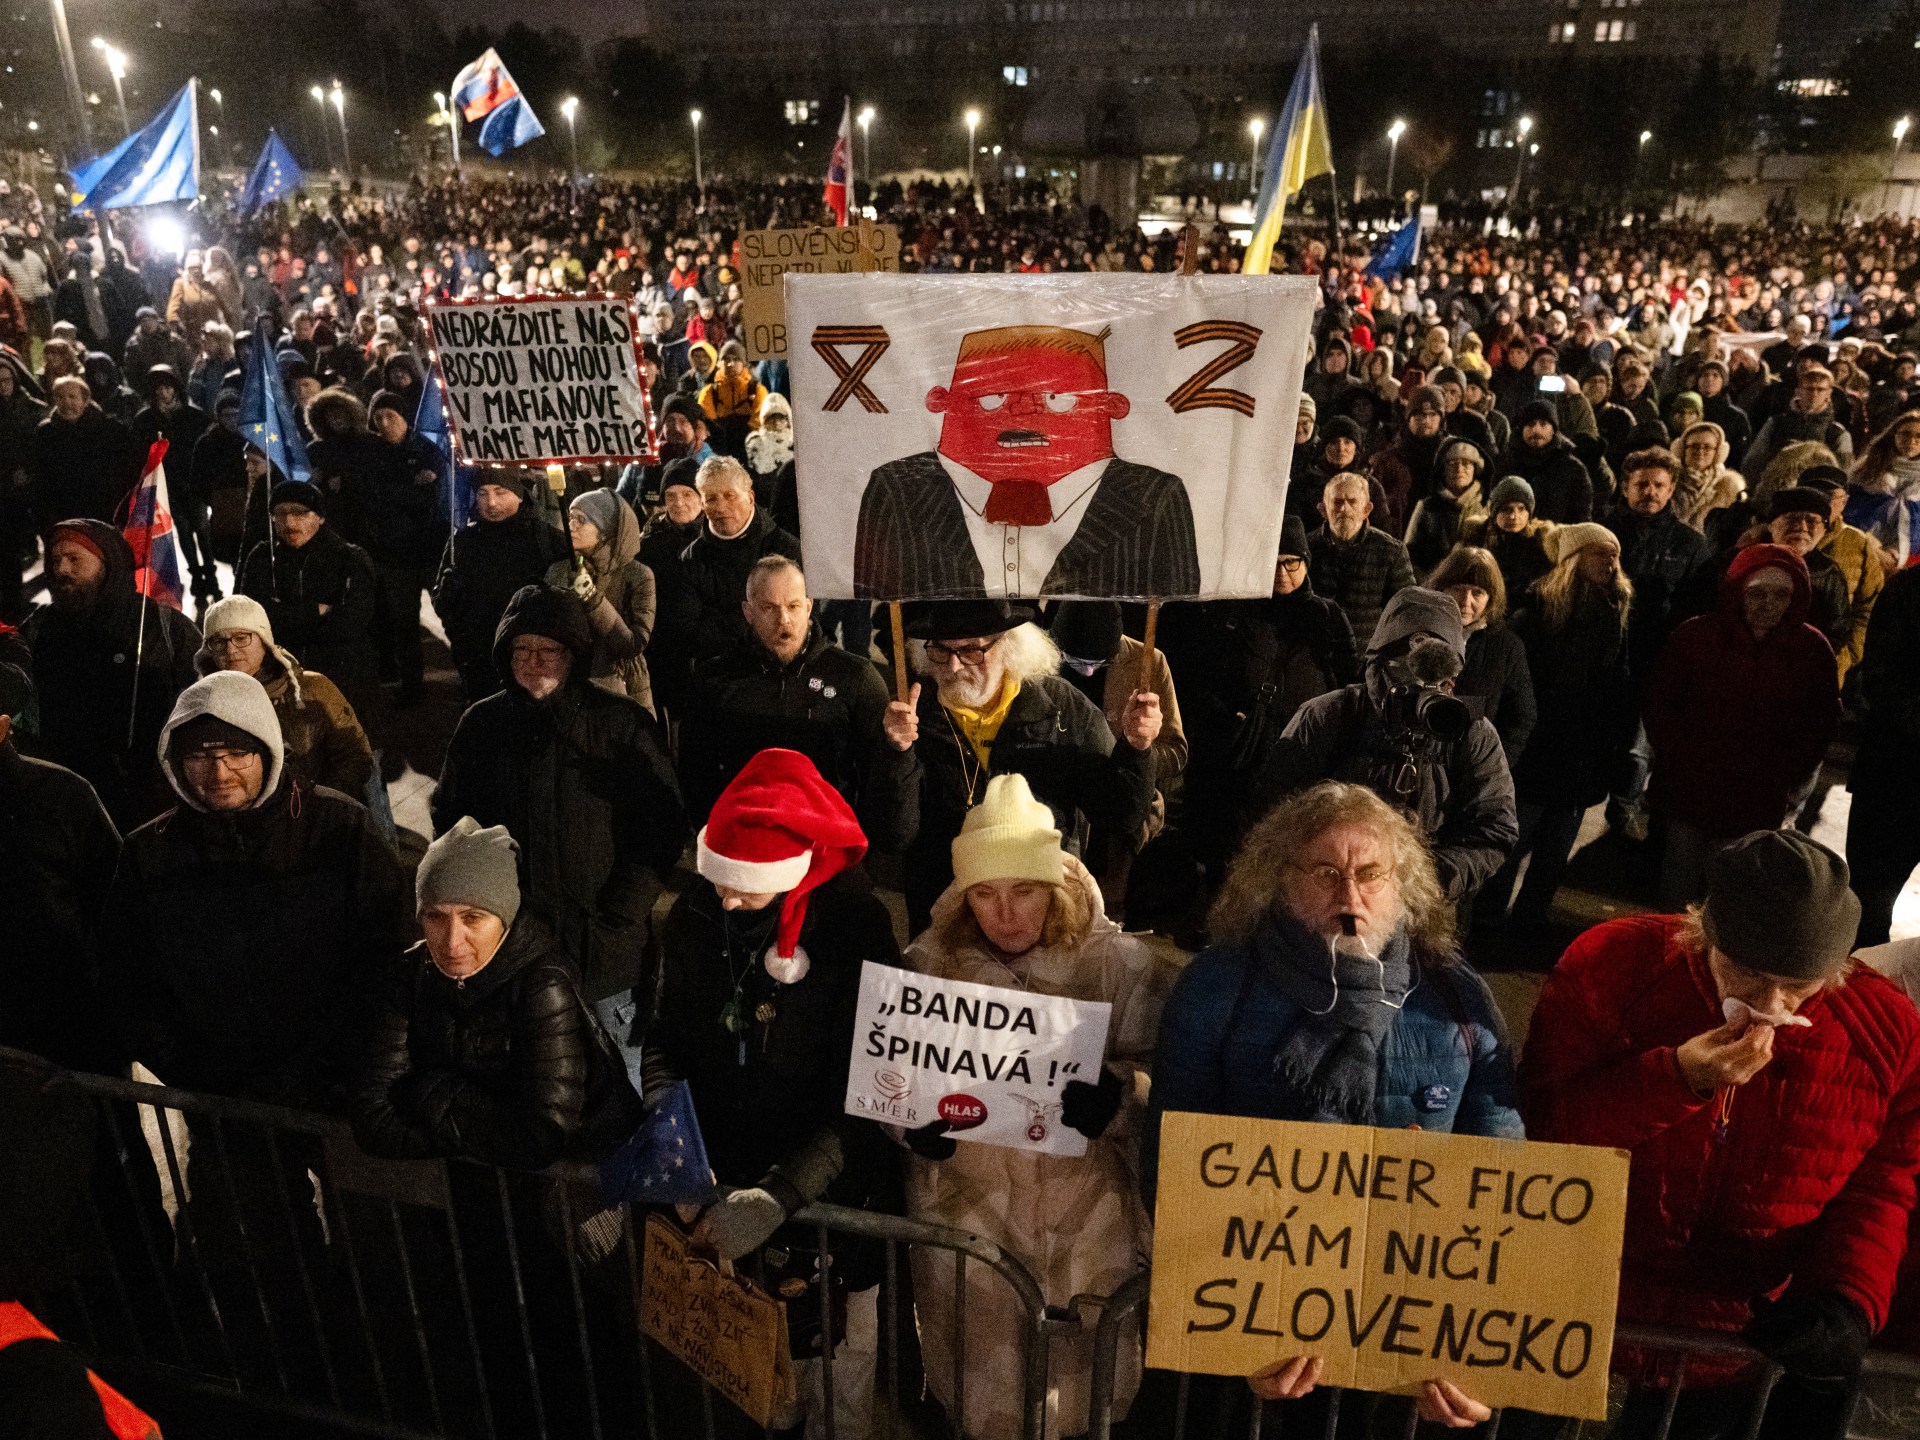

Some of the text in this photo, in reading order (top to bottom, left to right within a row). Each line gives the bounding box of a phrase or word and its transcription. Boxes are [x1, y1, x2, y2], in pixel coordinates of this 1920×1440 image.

[431, 303, 630, 348] NEDRÁŽDITE NÁS
[441, 350, 518, 387] BOSOU
[451, 385, 624, 424] V MAFIÁNOVE
[461, 419, 648, 460] MÁME MAŤ DETI?
[878, 986, 1037, 1036] „BANDA
[866, 1021, 1032, 1084] ŠPINAVÁ
[856, 1096, 917, 1122] SMER
[944, 1103, 981, 1117] HLAS
[1200, 1142, 1594, 1226] GAUNER FICO
[1221, 1205, 1515, 1285] NÁM NIČÍ
[1187, 1278, 1593, 1380] SLOVENSKO
